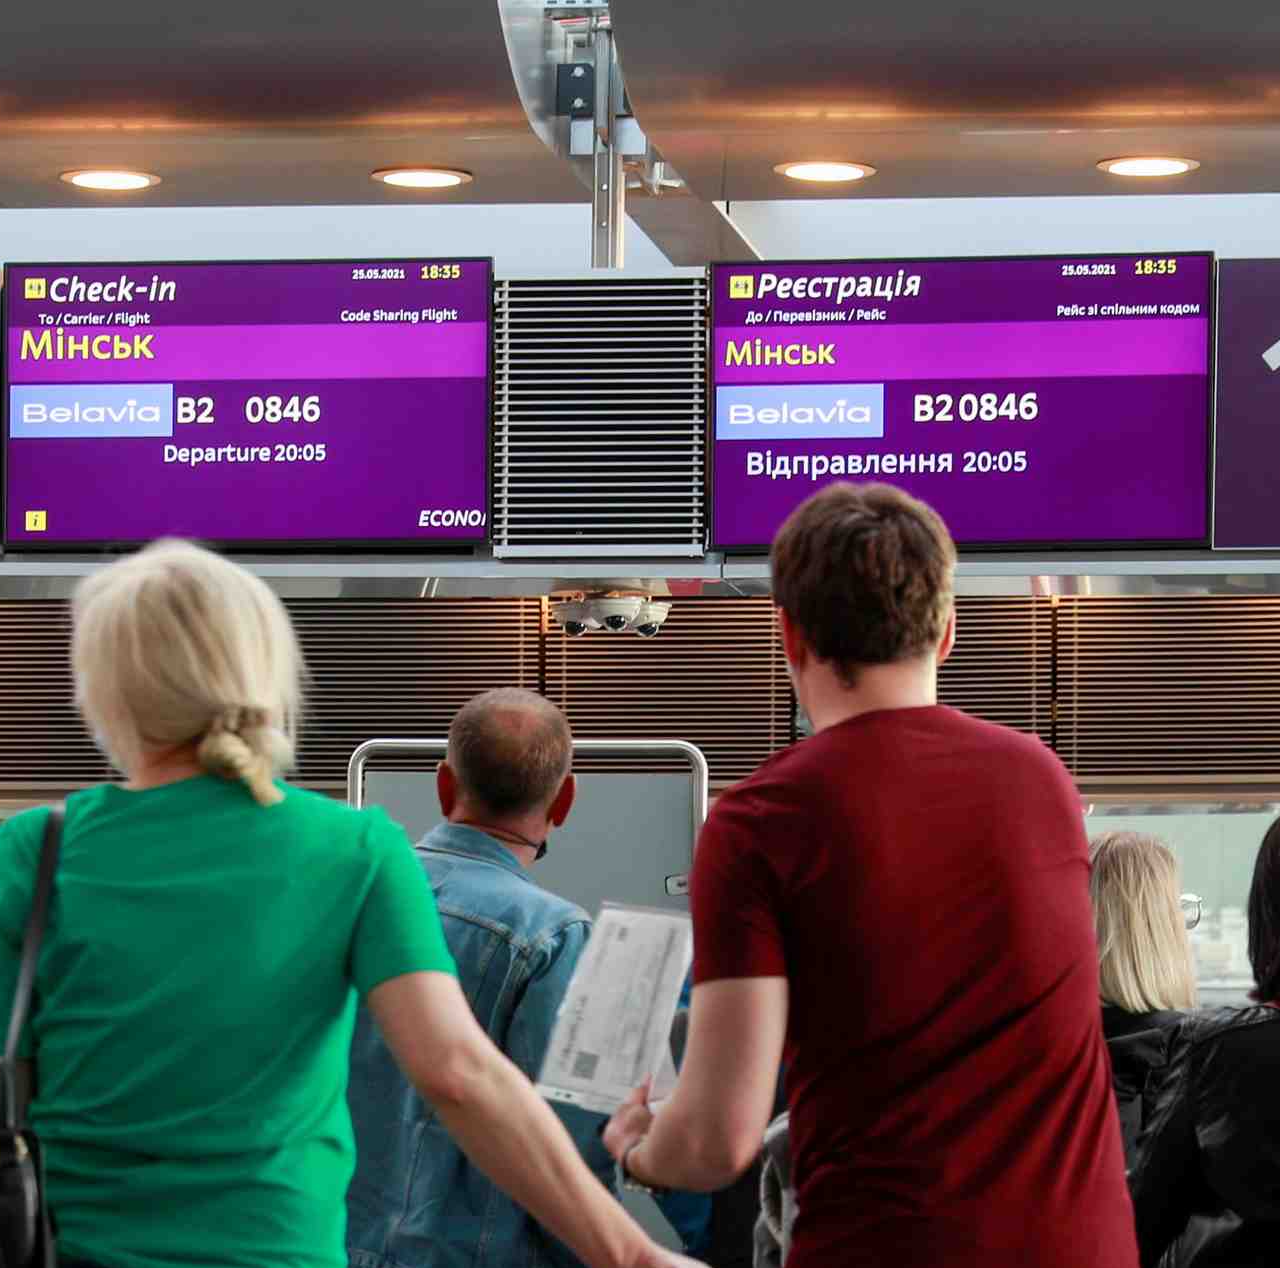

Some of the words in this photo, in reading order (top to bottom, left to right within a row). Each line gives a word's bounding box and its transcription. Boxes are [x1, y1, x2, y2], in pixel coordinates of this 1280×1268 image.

[353, 269, 404, 279] 25.05.2021
[422, 265, 460, 278] 18:35
[1062, 264, 1116, 275] 25.05.2021
[1135, 260, 1176, 274] 18:35
[50, 276, 176, 302] Check-in
[758, 270, 921, 304] Реєстрація
[39, 314, 54, 324] To
[64, 313, 105, 324] Carrier
[115, 312, 150, 326] Flight
[341, 310, 370, 321] Code
[373, 309, 418, 323] Sharing
[422, 309, 457, 323] Flight
[746, 311, 763, 324] До
[774, 310, 845, 324] Перевізник
[857, 309, 886, 320] Рейс
[1057, 305, 1083, 315] Рейс
[1100, 304, 1157, 315] спільним
[1160, 304, 1199, 315] кодом
[21, 329, 153, 359] Мінськ
[726, 339, 835, 365] Мінськ
[22, 399, 161, 424] Belavia
[177, 397, 214, 423] B2
[246, 396, 320, 422] 0846
[728, 399, 870, 425] Belavia
[915, 394, 953, 421] B2
[959, 393, 1038, 421] 0846
[164, 444, 271, 466] Departure
[275, 444, 325, 461] 20:05
[747, 450, 952, 480] Відправлення
[963, 451, 1026, 472] 20:05
[419, 510, 486, 526] ECONO
